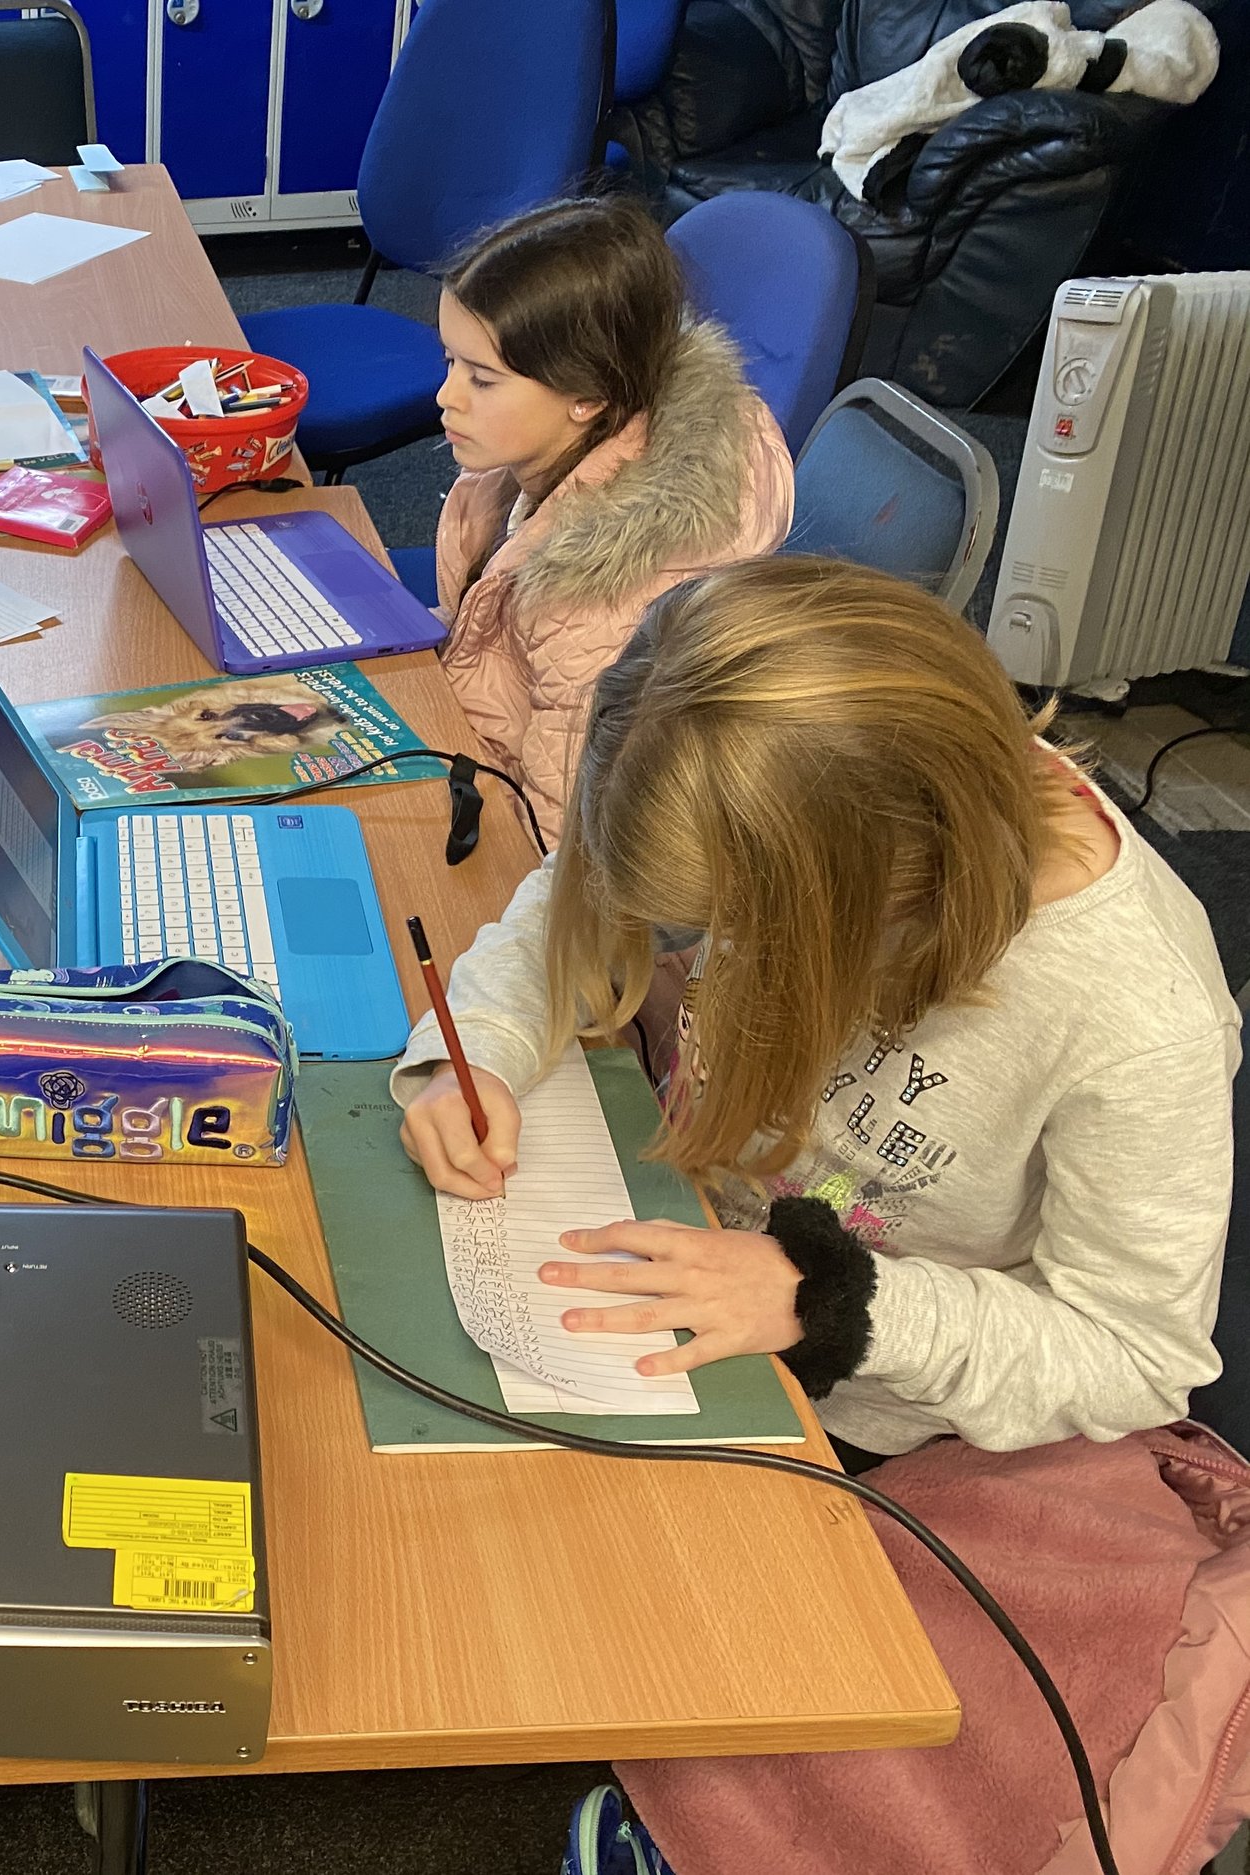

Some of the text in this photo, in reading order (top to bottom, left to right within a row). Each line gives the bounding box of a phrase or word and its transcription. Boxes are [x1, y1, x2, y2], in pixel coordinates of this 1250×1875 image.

[312, 670, 400, 730] or want to be vets!
[297, 672, 399, 745] For kids who love pets
[56, 740, 178, 795] Animal
[77, 777, 103, 800] pdsa
[353, 1104, 395, 1112] Silvine
[509, 1292, 528, 1301] 80
[516, 1303, 530, 1314] 79
[516, 1314, 532, 1323] 78
[519, 1325, 536, 1333] 77
[523, 1334, 539, 1342] 76
[122, 1700, 226, 1714] TOSHIBA
